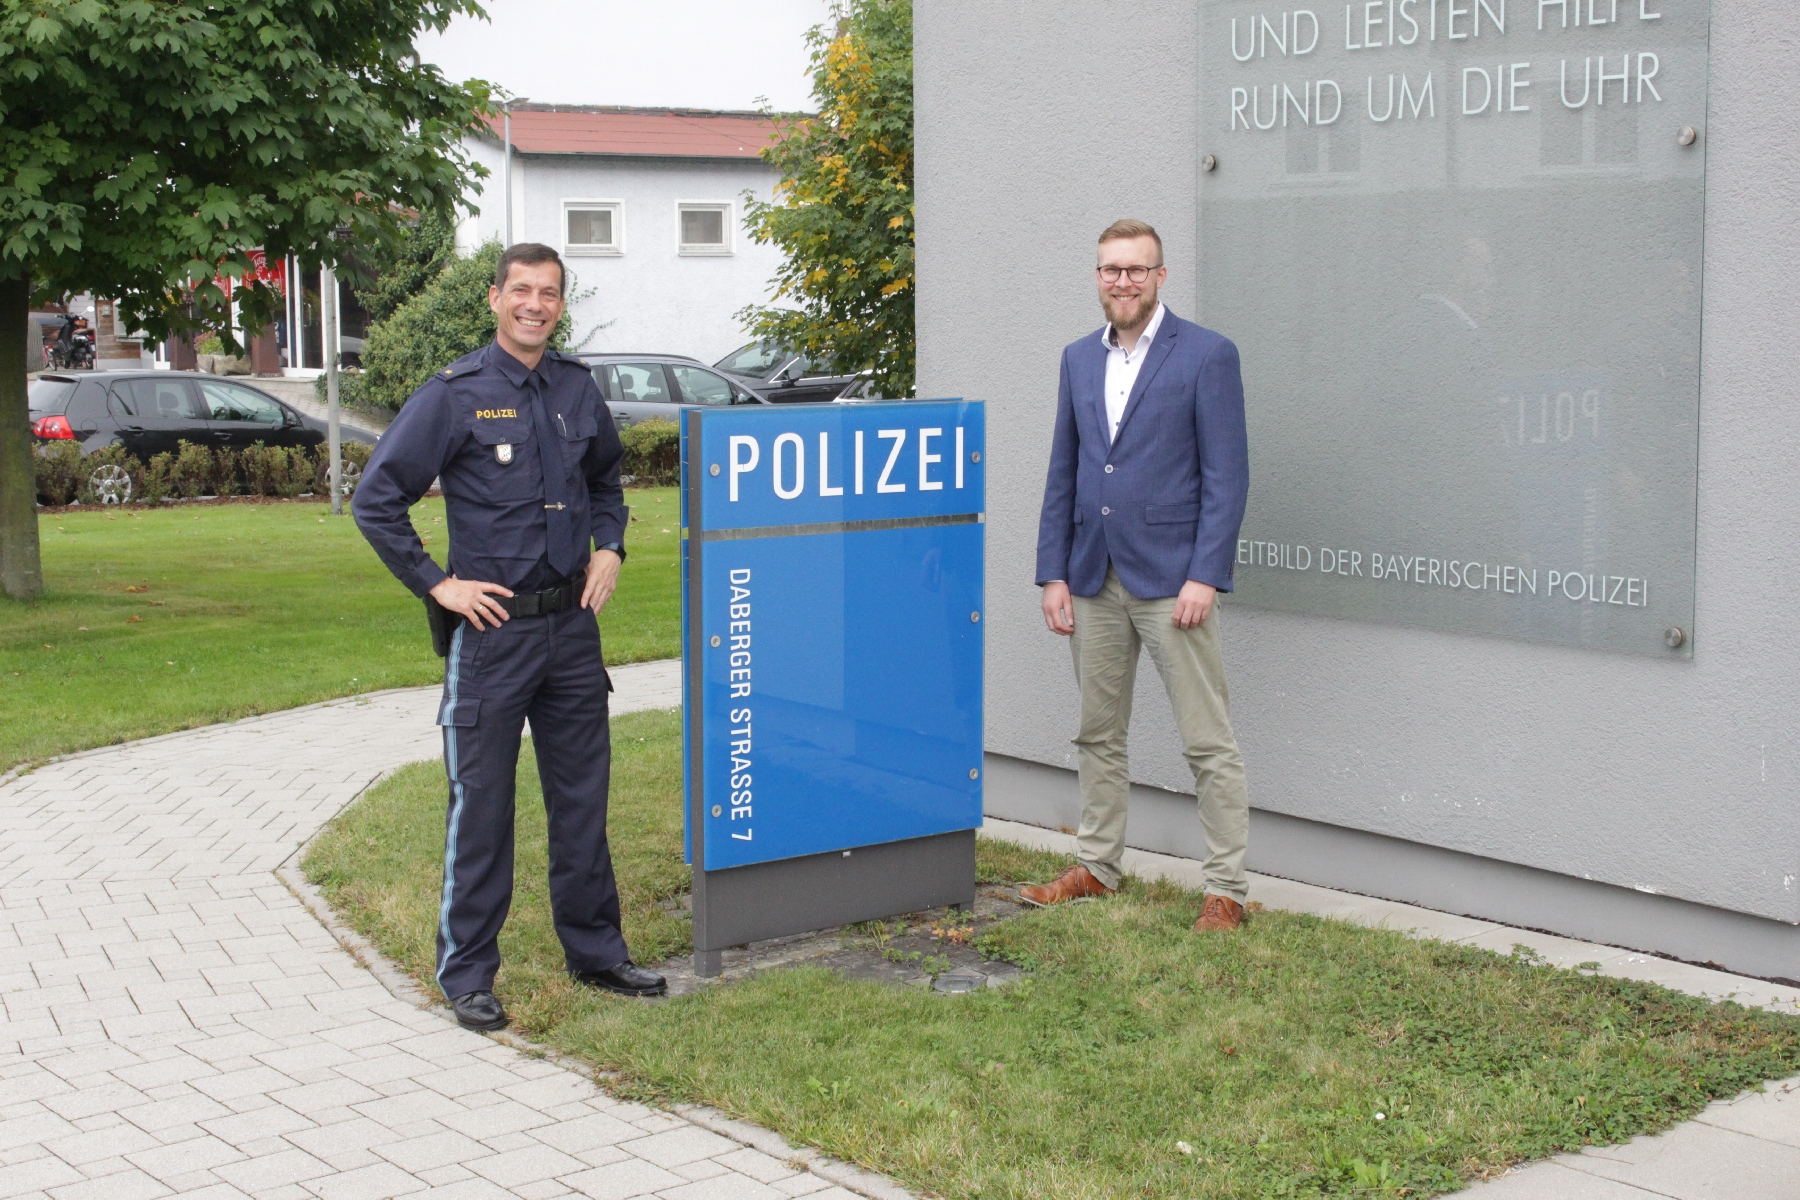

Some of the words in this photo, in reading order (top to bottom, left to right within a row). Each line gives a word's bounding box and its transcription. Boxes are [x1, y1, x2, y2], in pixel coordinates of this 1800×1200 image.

[1231, 9, 1319, 61] UND
[1345, 0, 1505, 50] LEISTEN
[1231, 80, 1342, 131] RUND
[1367, 71, 1435, 122] UM
[1462, 62, 1531, 115] DIE
[1560, 52, 1662, 109] UHR
[476, 409, 517, 419] POLIZEI
[729, 426, 964, 502] POLIZEI
[1235, 539, 1312, 571] EITBILD
[1320, 547, 1363, 577] DER
[1372, 553, 1537, 595] BAYERISCHEN
[1548, 570, 1648, 607] POLIZEI
[729, 568, 752, 699] DABERGER
[730, 708, 752, 821] STRASSE
[731, 828, 753, 842] 7
